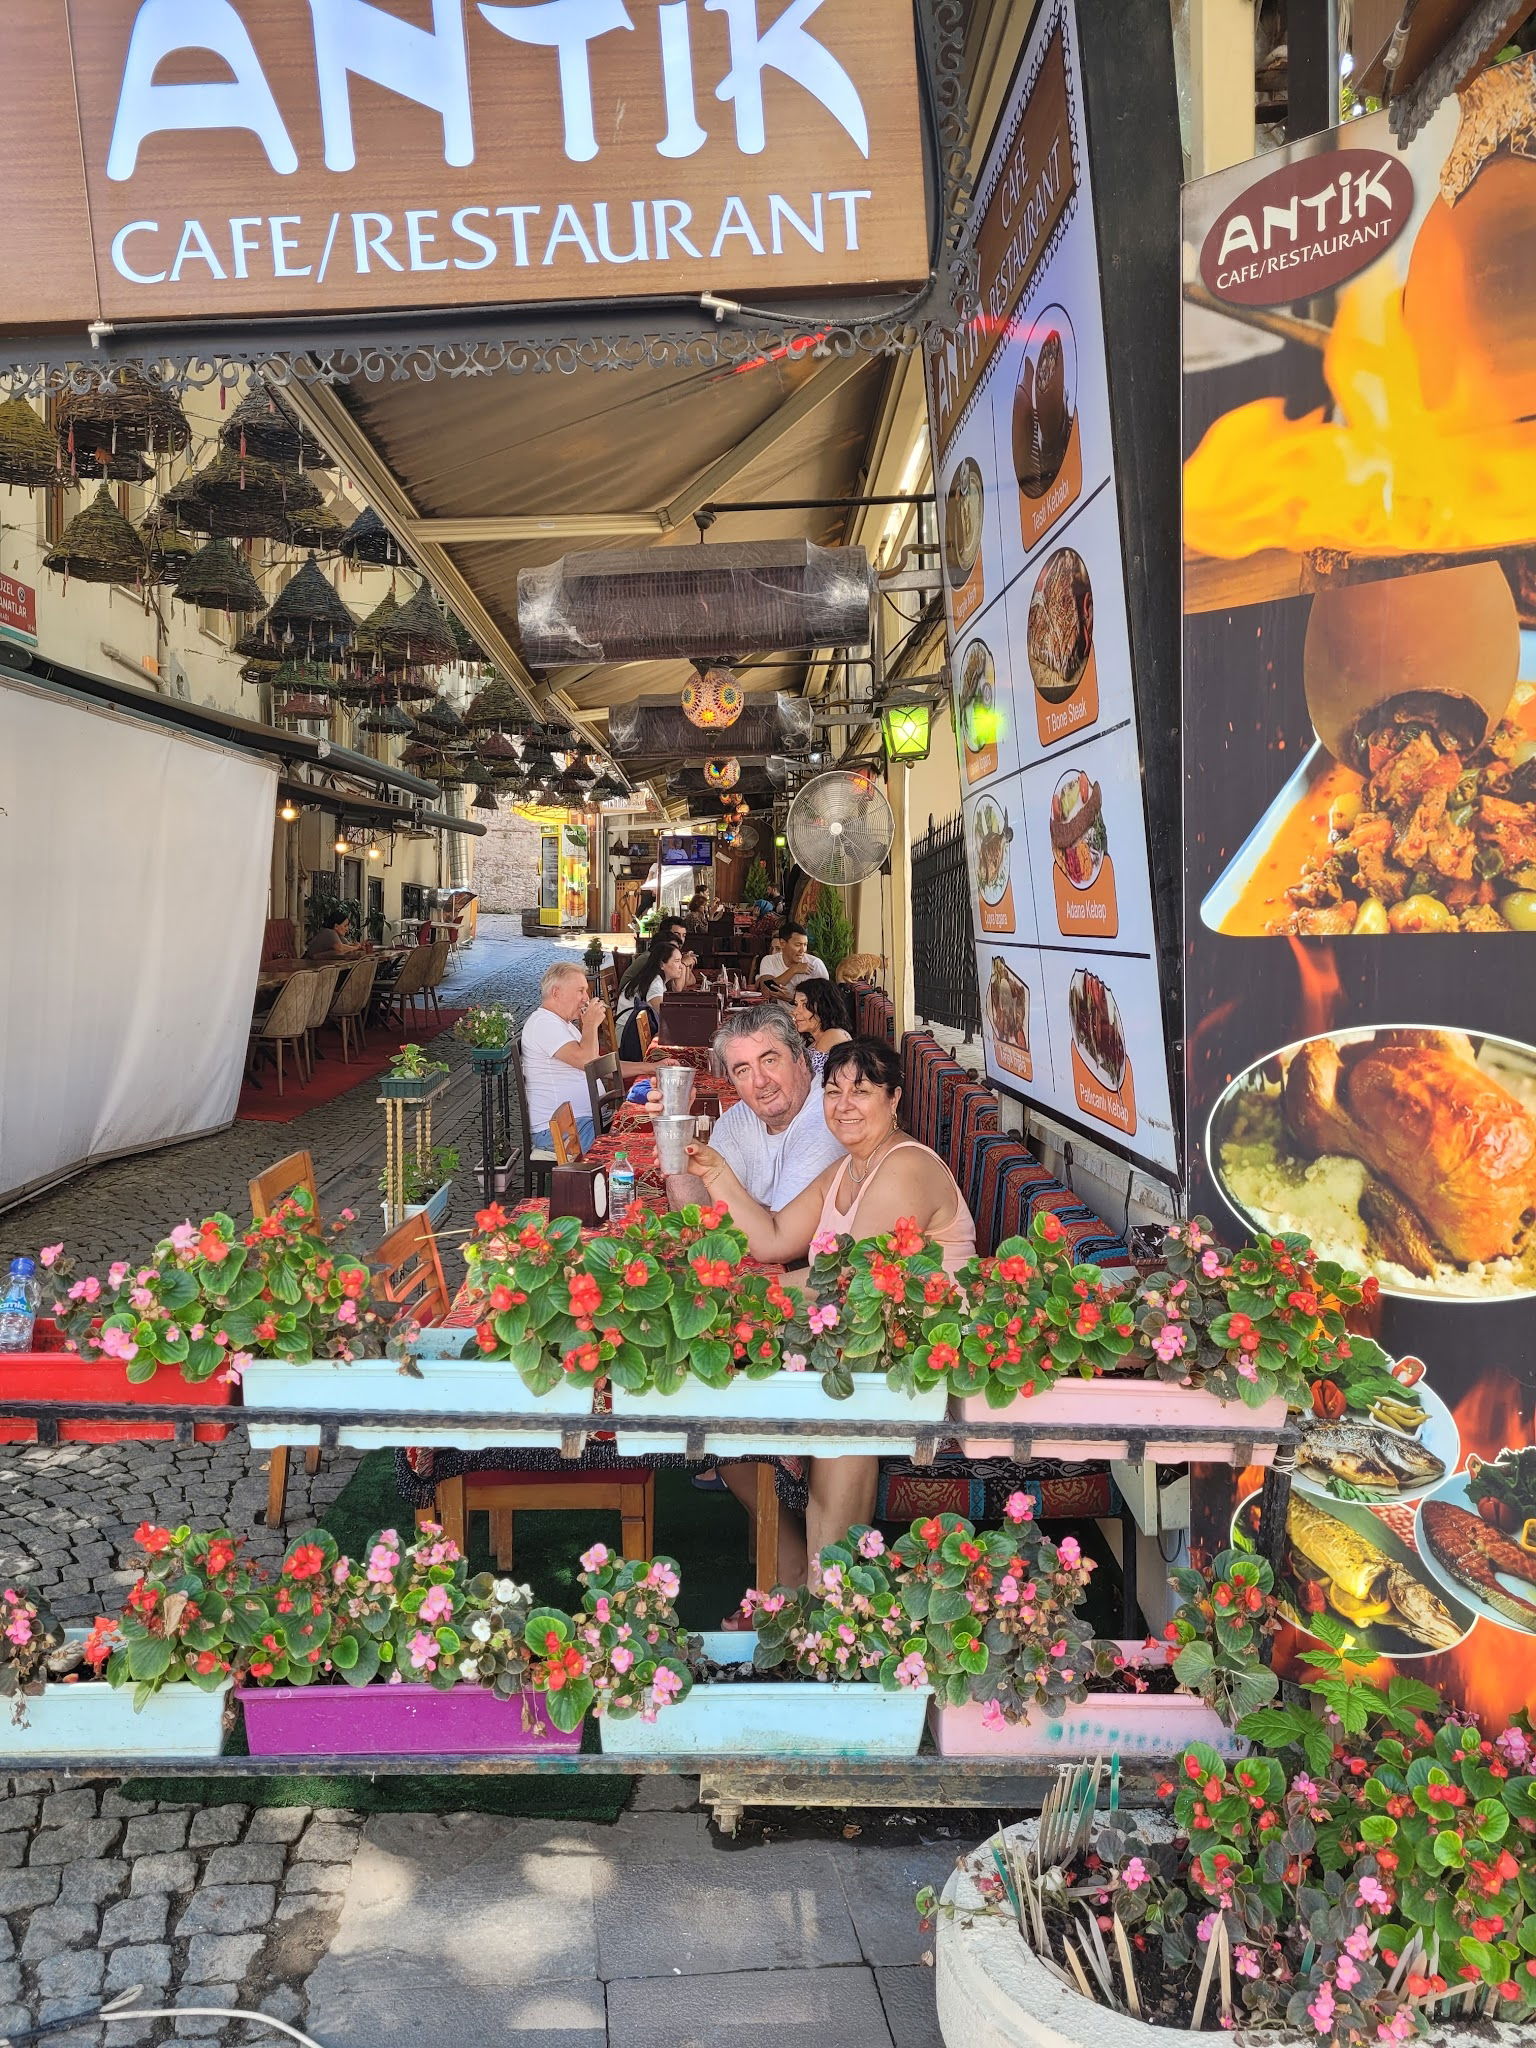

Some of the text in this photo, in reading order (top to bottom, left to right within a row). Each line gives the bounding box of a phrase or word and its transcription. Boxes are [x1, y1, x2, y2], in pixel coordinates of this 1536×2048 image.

[1001, 135, 1029, 229] CAFE
[111, 190, 872, 285] CAFE/RESTAURANT
[989, 135, 1060, 331] RESTAURANT
[1216, 218, 1392, 290] CAFE/RESTAURANT
[1045, 695, 1087, 735] T Bone Steak
[1066, 899, 1107, 925] Adana Kebap
[1107, 1095, 1129, 1127] Kebap
